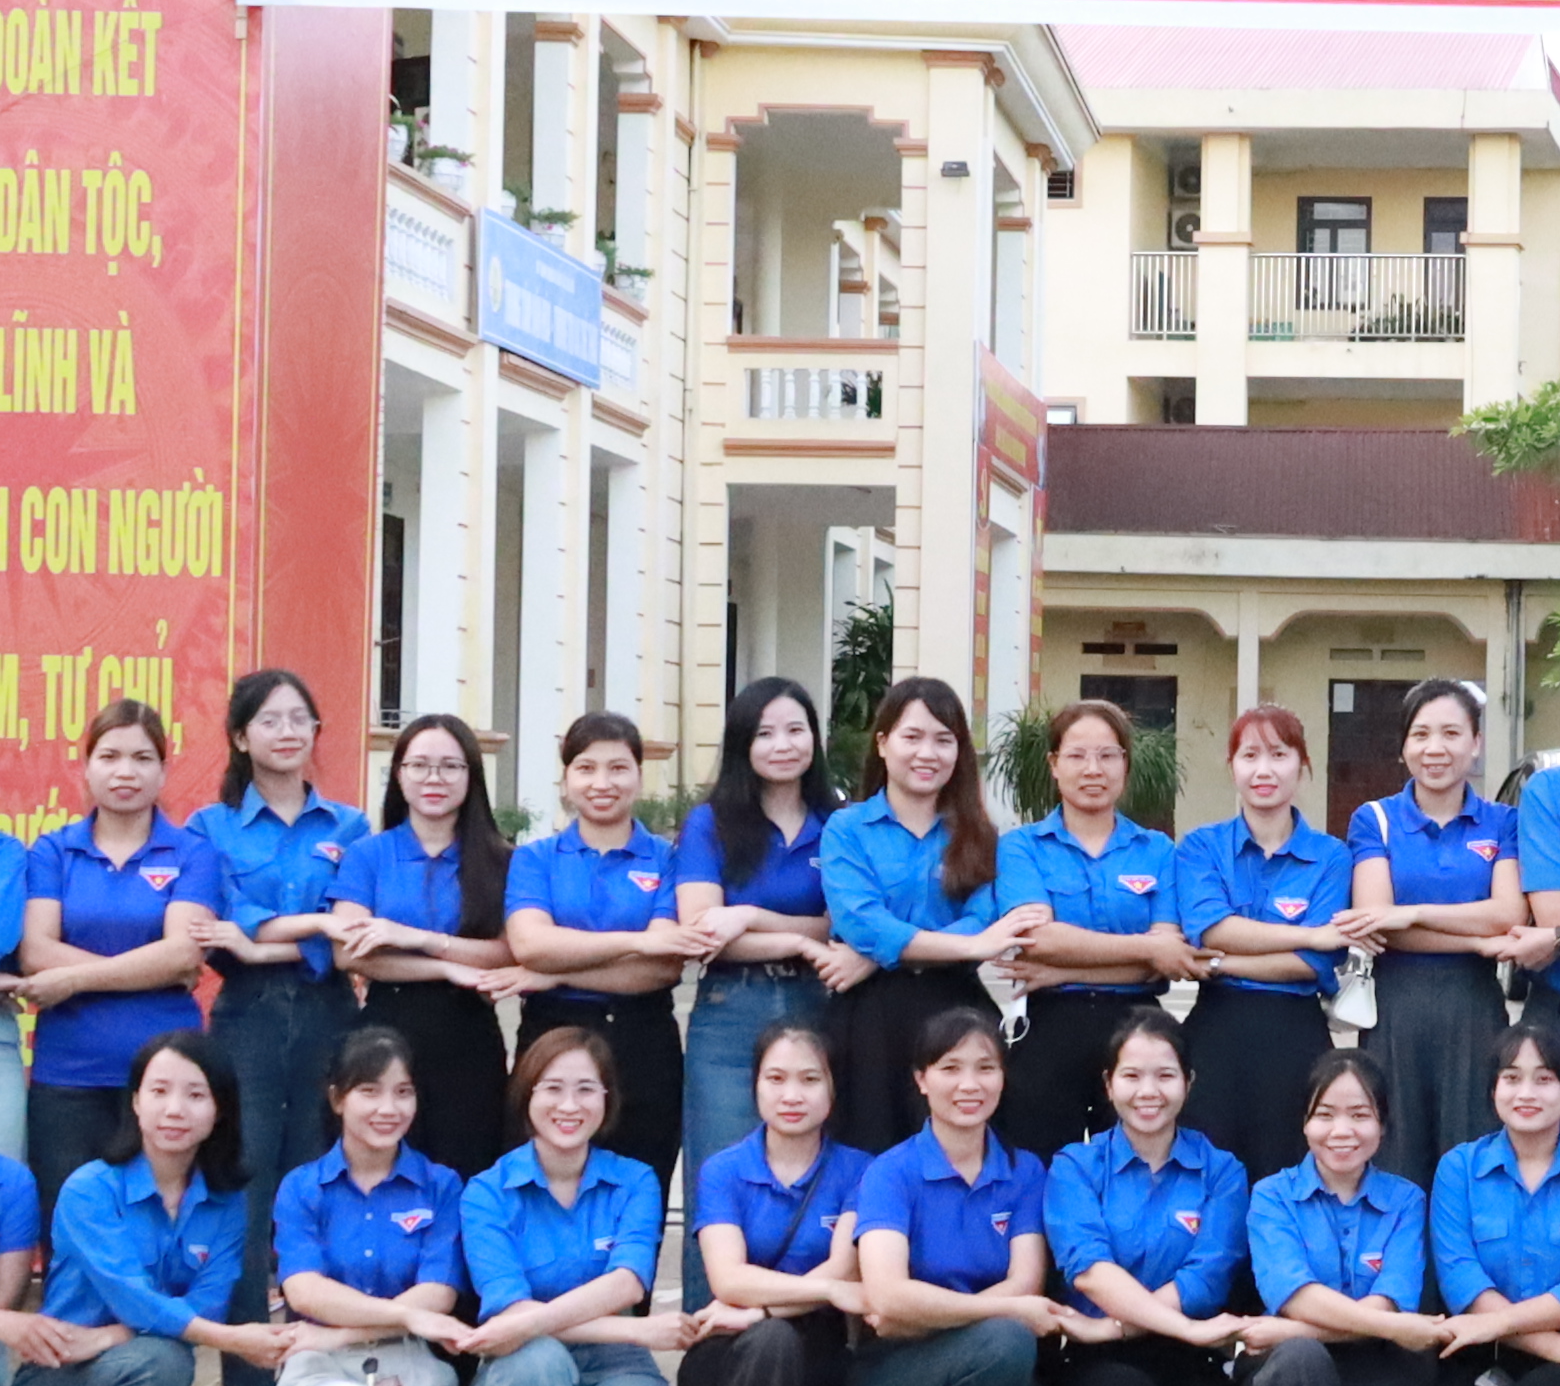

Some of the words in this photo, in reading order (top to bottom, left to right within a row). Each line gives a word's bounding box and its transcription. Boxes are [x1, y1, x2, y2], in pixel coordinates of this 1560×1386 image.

[82, 152, 161, 273] TỘC,
[89, 312, 136, 414] VÀ
[20, 487, 98, 573] CON
[109, 468, 224, 576] NGƯỜI
[42, 647, 93, 759] TỰ
